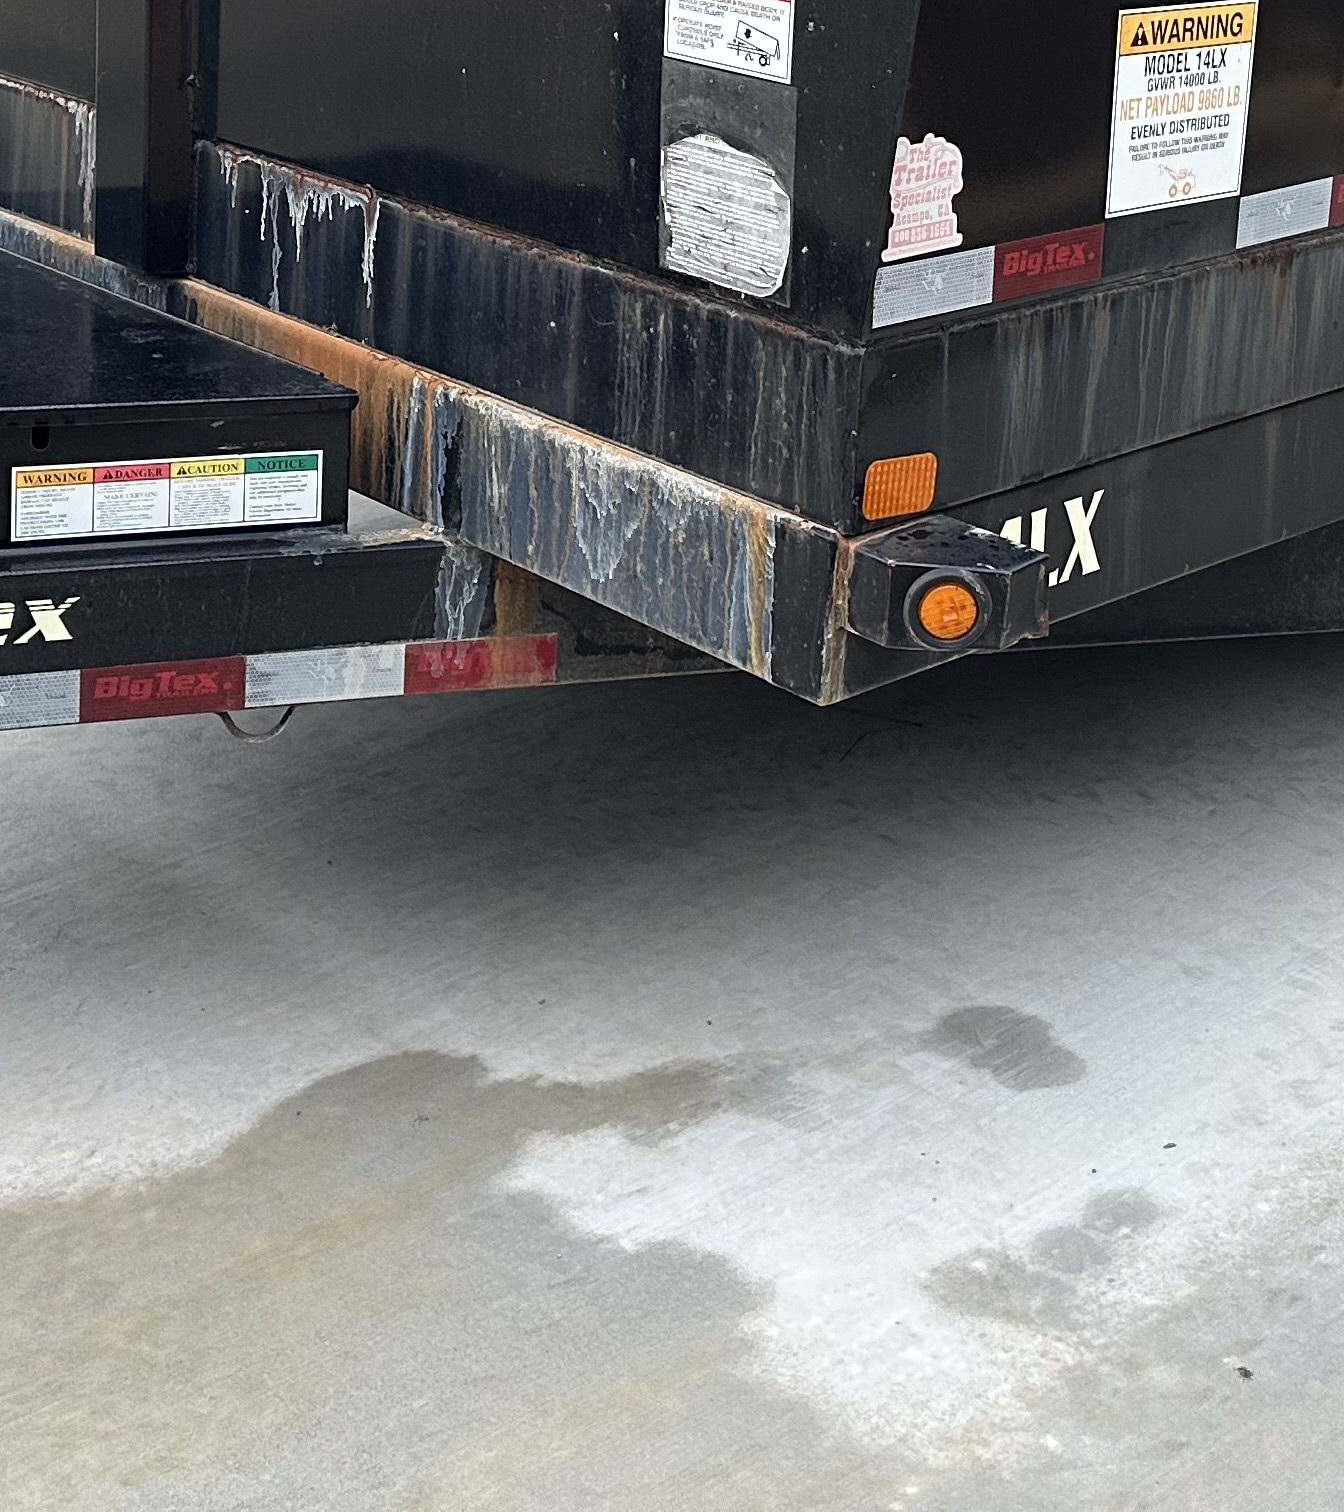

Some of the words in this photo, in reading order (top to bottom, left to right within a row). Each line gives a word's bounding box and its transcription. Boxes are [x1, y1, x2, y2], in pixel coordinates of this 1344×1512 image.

[1150, 12, 1244, 46] WARNING
[1144, 51, 1191, 78] MODEL
[1196, 46, 1228, 71] 14LX
[1147, 75, 1176, 93] GVWR
[1179, 71, 1206, 89] 14000
[1119, 97, 1143, 122] NET
[1144, 90, 1195, 119] PAYLOAD
[1197, 86, 1225, 112] 9860
[1130, 121, 1167, 141] EVENLY
[1169, 113, 1230, 135] DISTRIBUTED
[894, 159, 957, 187] Trailer
[892, 184, 953, 212] Specialist
[937, 202, 950, 218] CA
[1003, 242, 1088, 276] BigTex
[22, 471, 88, 485] WARNING
[114, 467, 164, 480] DANGER
[187, 462, 239, 475] CAUTION
[258, 458, 305, 470] NOTICE
[94, 671, 219, 701] BigTex
